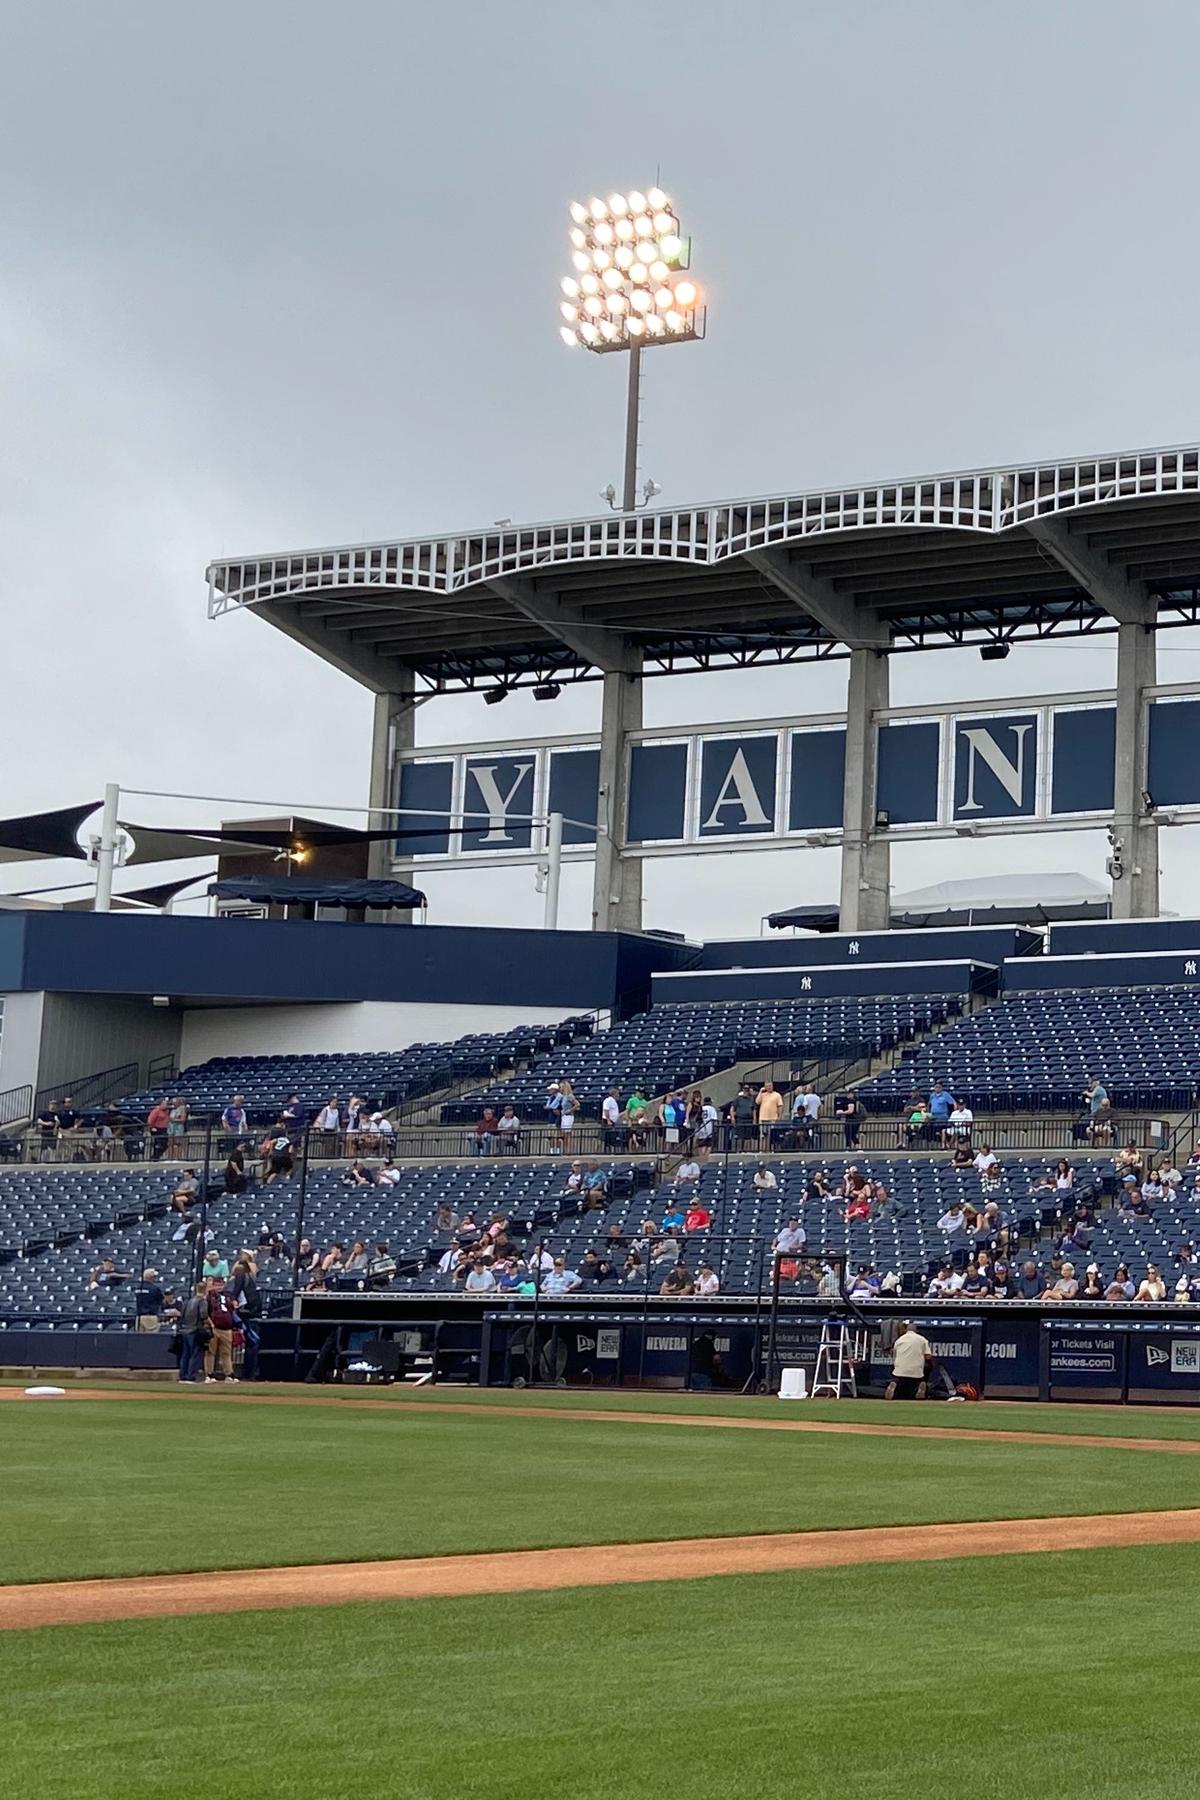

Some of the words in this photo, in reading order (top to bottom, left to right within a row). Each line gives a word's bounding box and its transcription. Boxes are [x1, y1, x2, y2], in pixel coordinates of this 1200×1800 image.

[1061, 1339, 1092, 1350] Tickets
[1094, 1341, 1115, 1350] Visit
[1176, 1346, 1197, 1356] NEW
[1050, 1356, 1111, 1368] ankees.com
[1176, 1356, 1196, 1366] ERA
